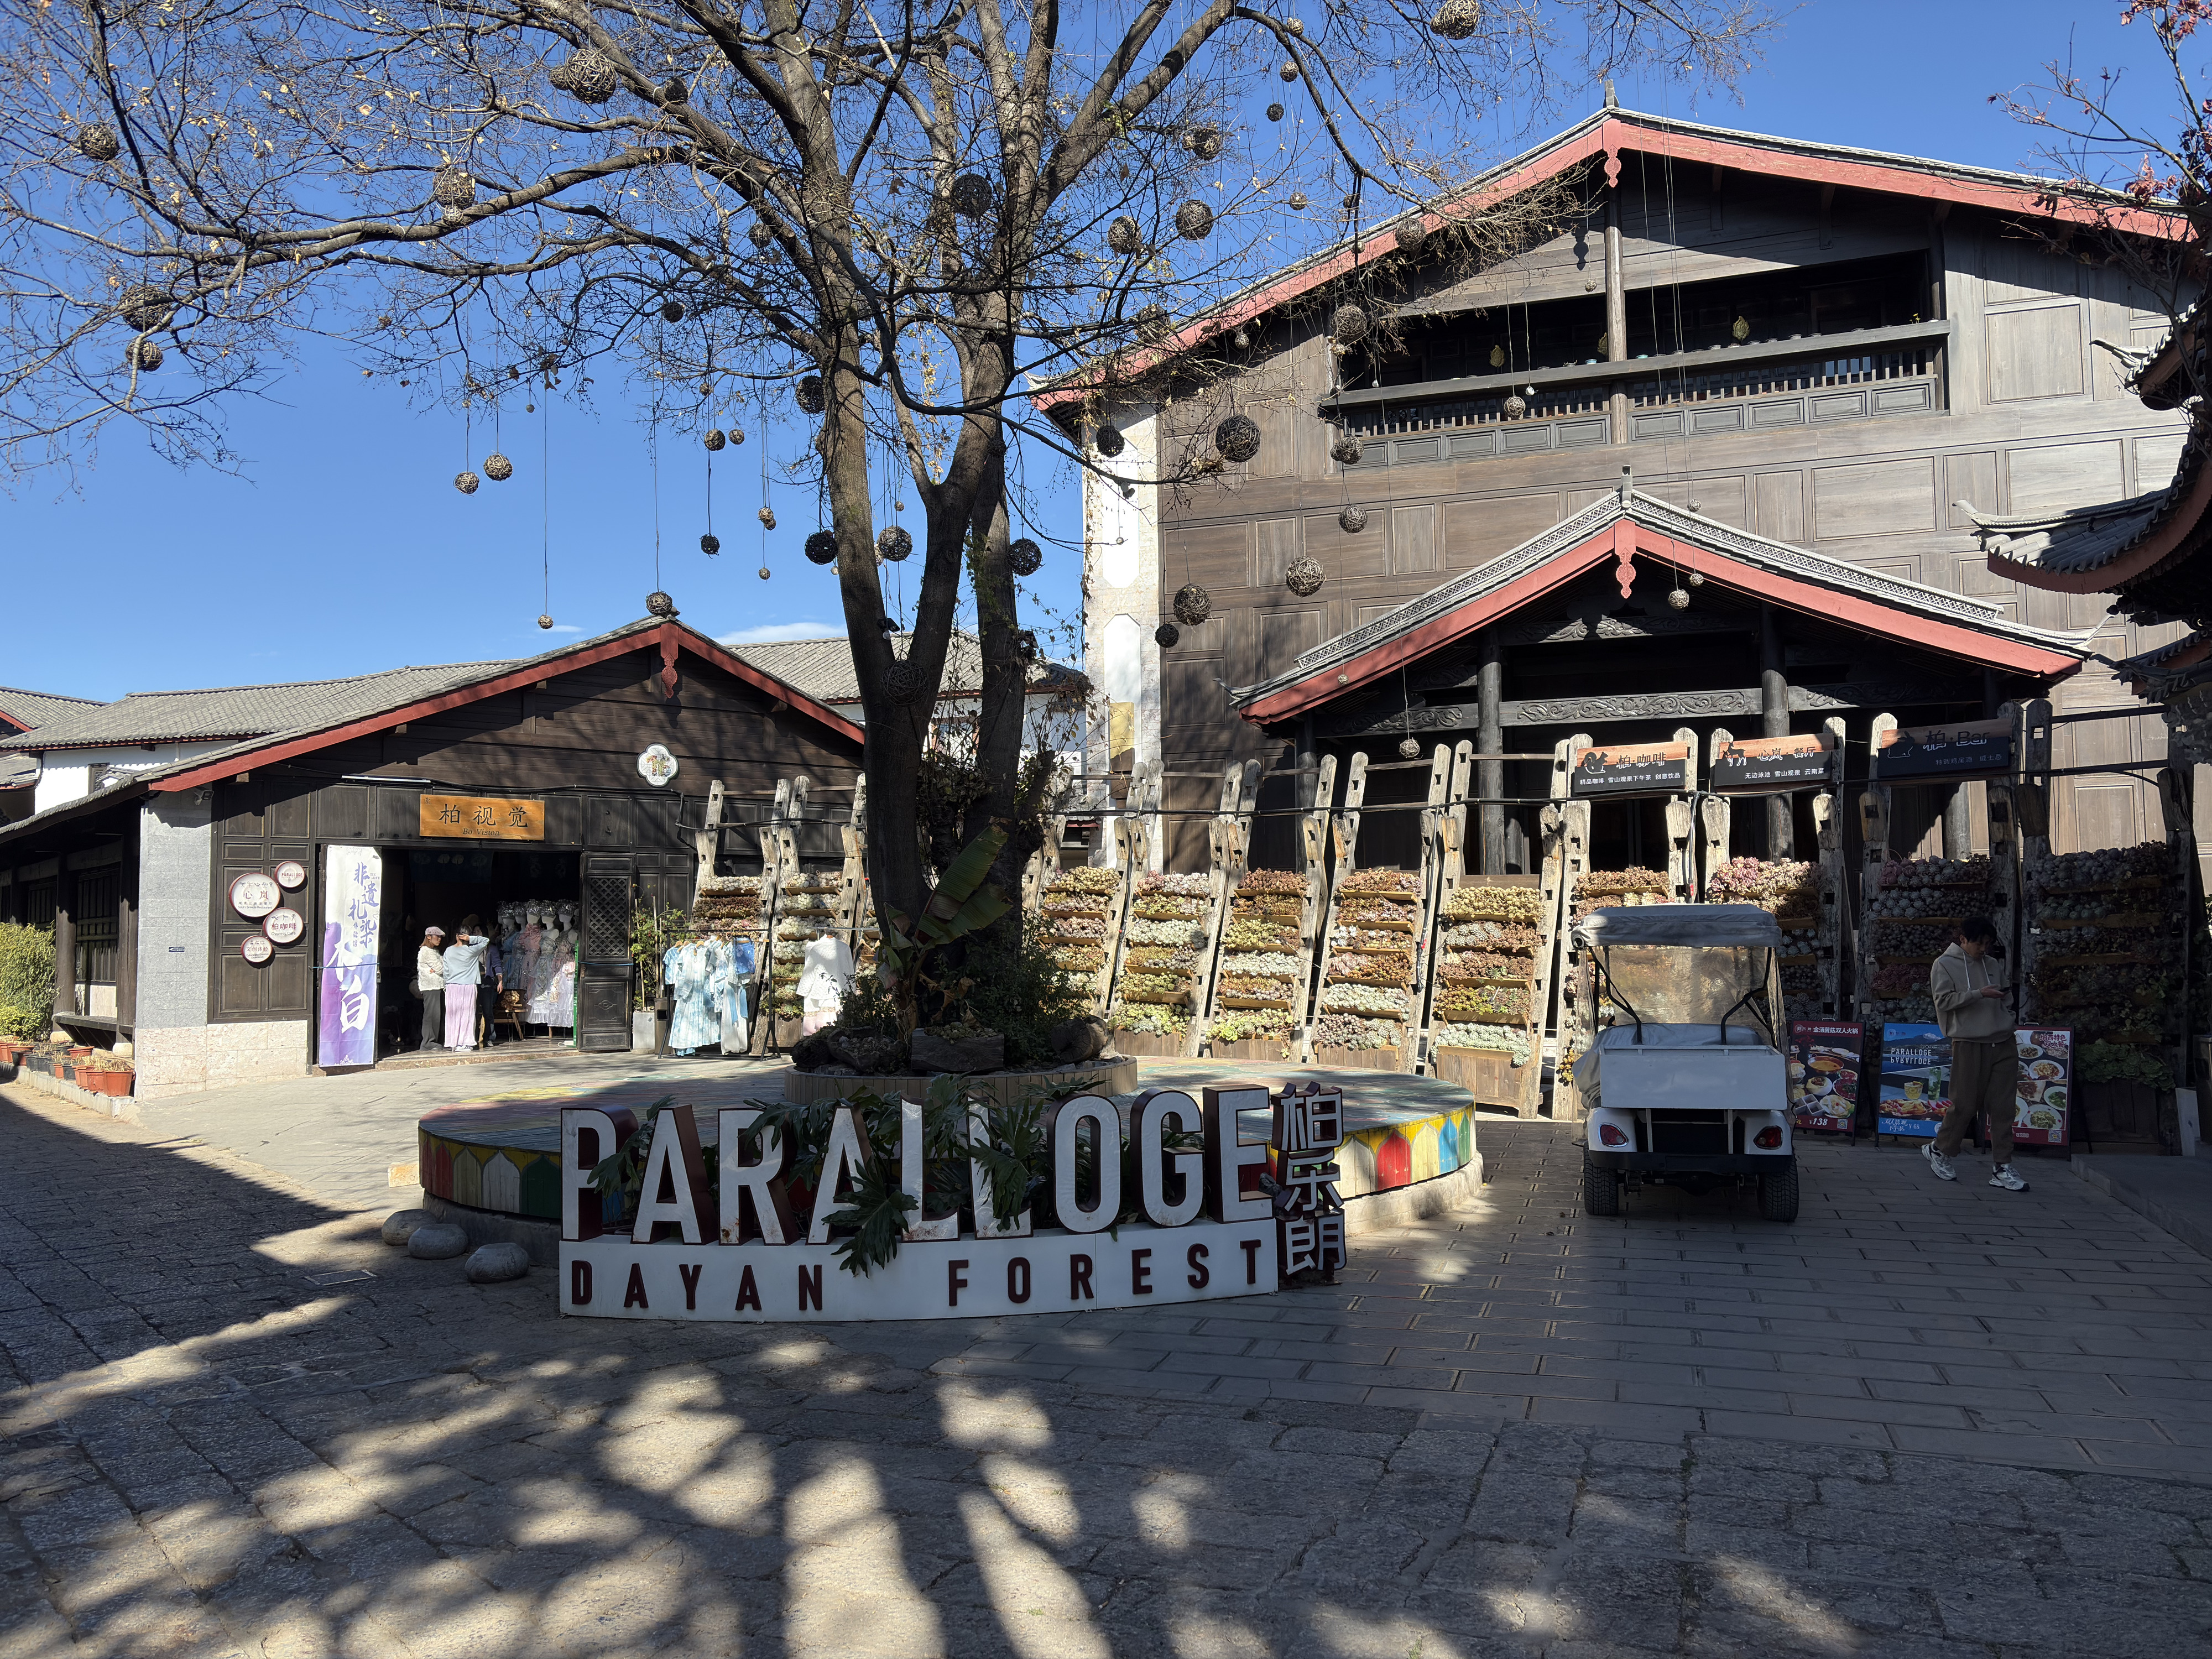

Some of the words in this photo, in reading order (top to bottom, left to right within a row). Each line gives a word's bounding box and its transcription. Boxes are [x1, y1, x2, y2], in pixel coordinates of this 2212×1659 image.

[1936, 756, 1973, 765] 特调鸡尾酒
[1979, 753, 2002, 761] 威士忌
[1579, 776, 1605, 785] 精品咖啡
[1608, 774, 1651, 783] 雪山观景下午茶
[1655, 772, 1681, 780] 创意饮品
[439, 803, 528, 828] 柏视觉
[243, 890, 269, 900] 心岚
[271, 922, 297, 931] 柏咖啡
[1813, 1026, 1858, 1035] 金汤菌菇双人火锅
[2038, 1033, 2067, 1041] 纳西特色
[1891, 1047, 1932, 1056] PARALLOGE
[561, 1085, 1270, 1245] PARALLOGE
[571, 1260, 823, 1311] DAYAN
[948, 1239, 1261, 1306] FOREST
